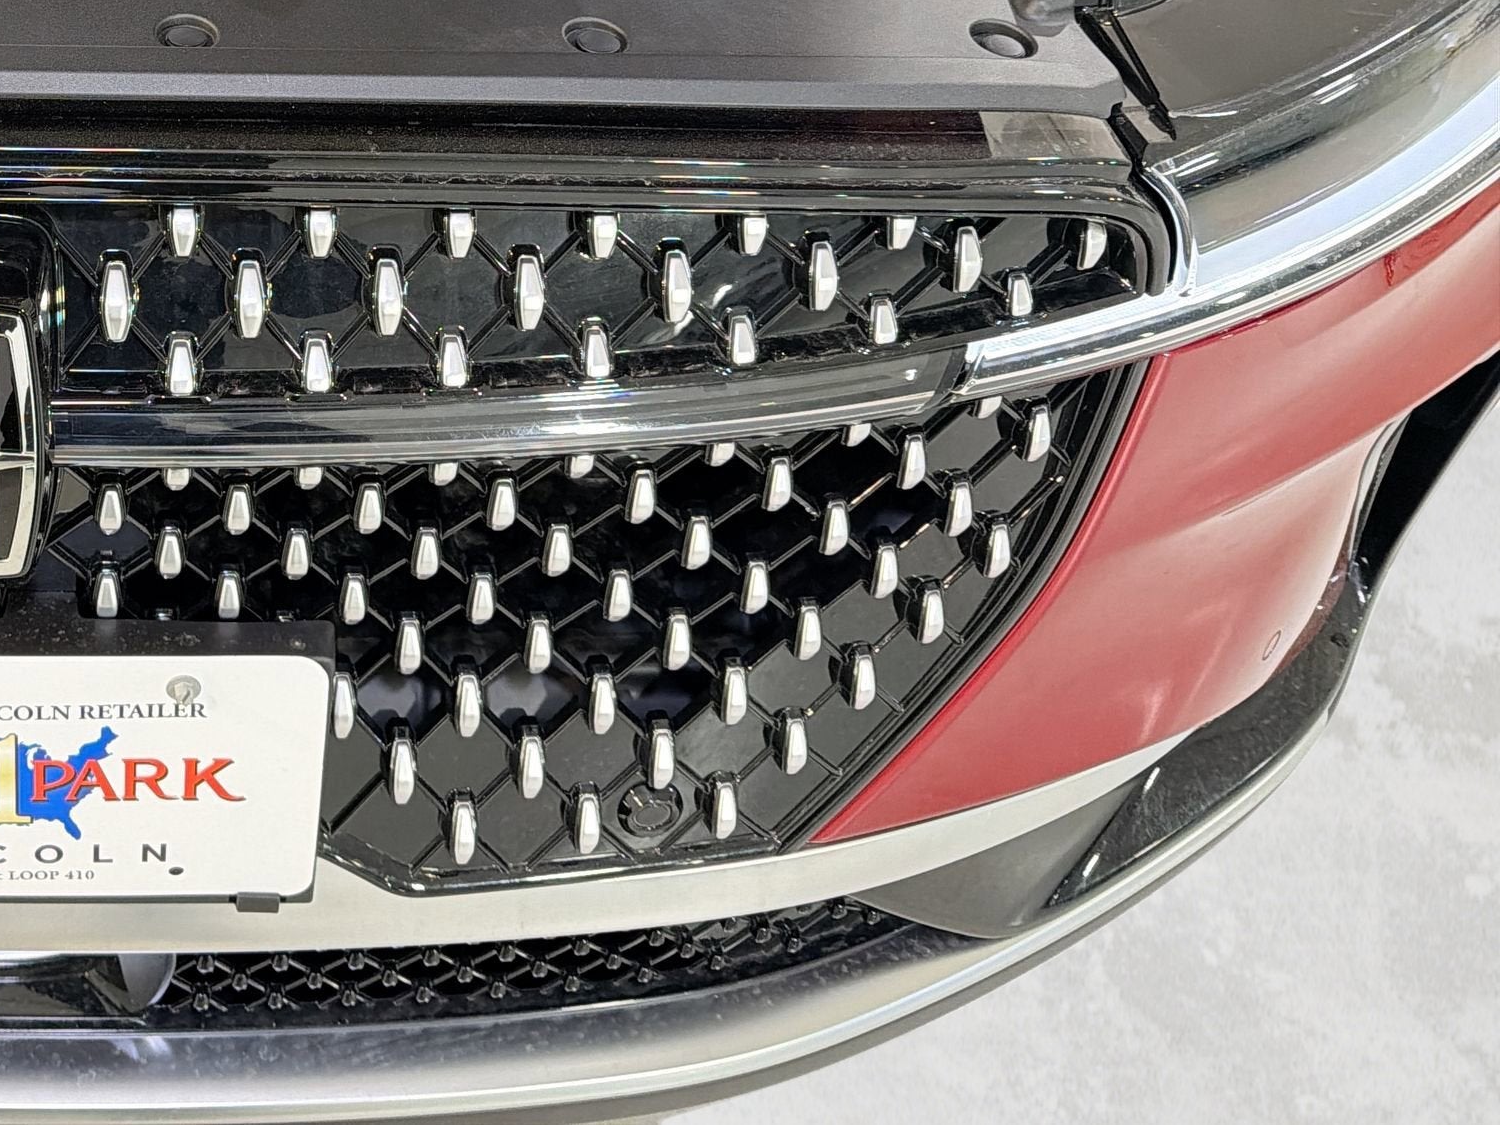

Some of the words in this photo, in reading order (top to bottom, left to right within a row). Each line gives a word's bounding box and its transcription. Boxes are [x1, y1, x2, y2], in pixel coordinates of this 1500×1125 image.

[78, 702, 208, 720] RETAILER
[29, 756, 246, 802] PARK
[8, 869, 60, 881] LOOP
[64, 869, 95, 881] 410
